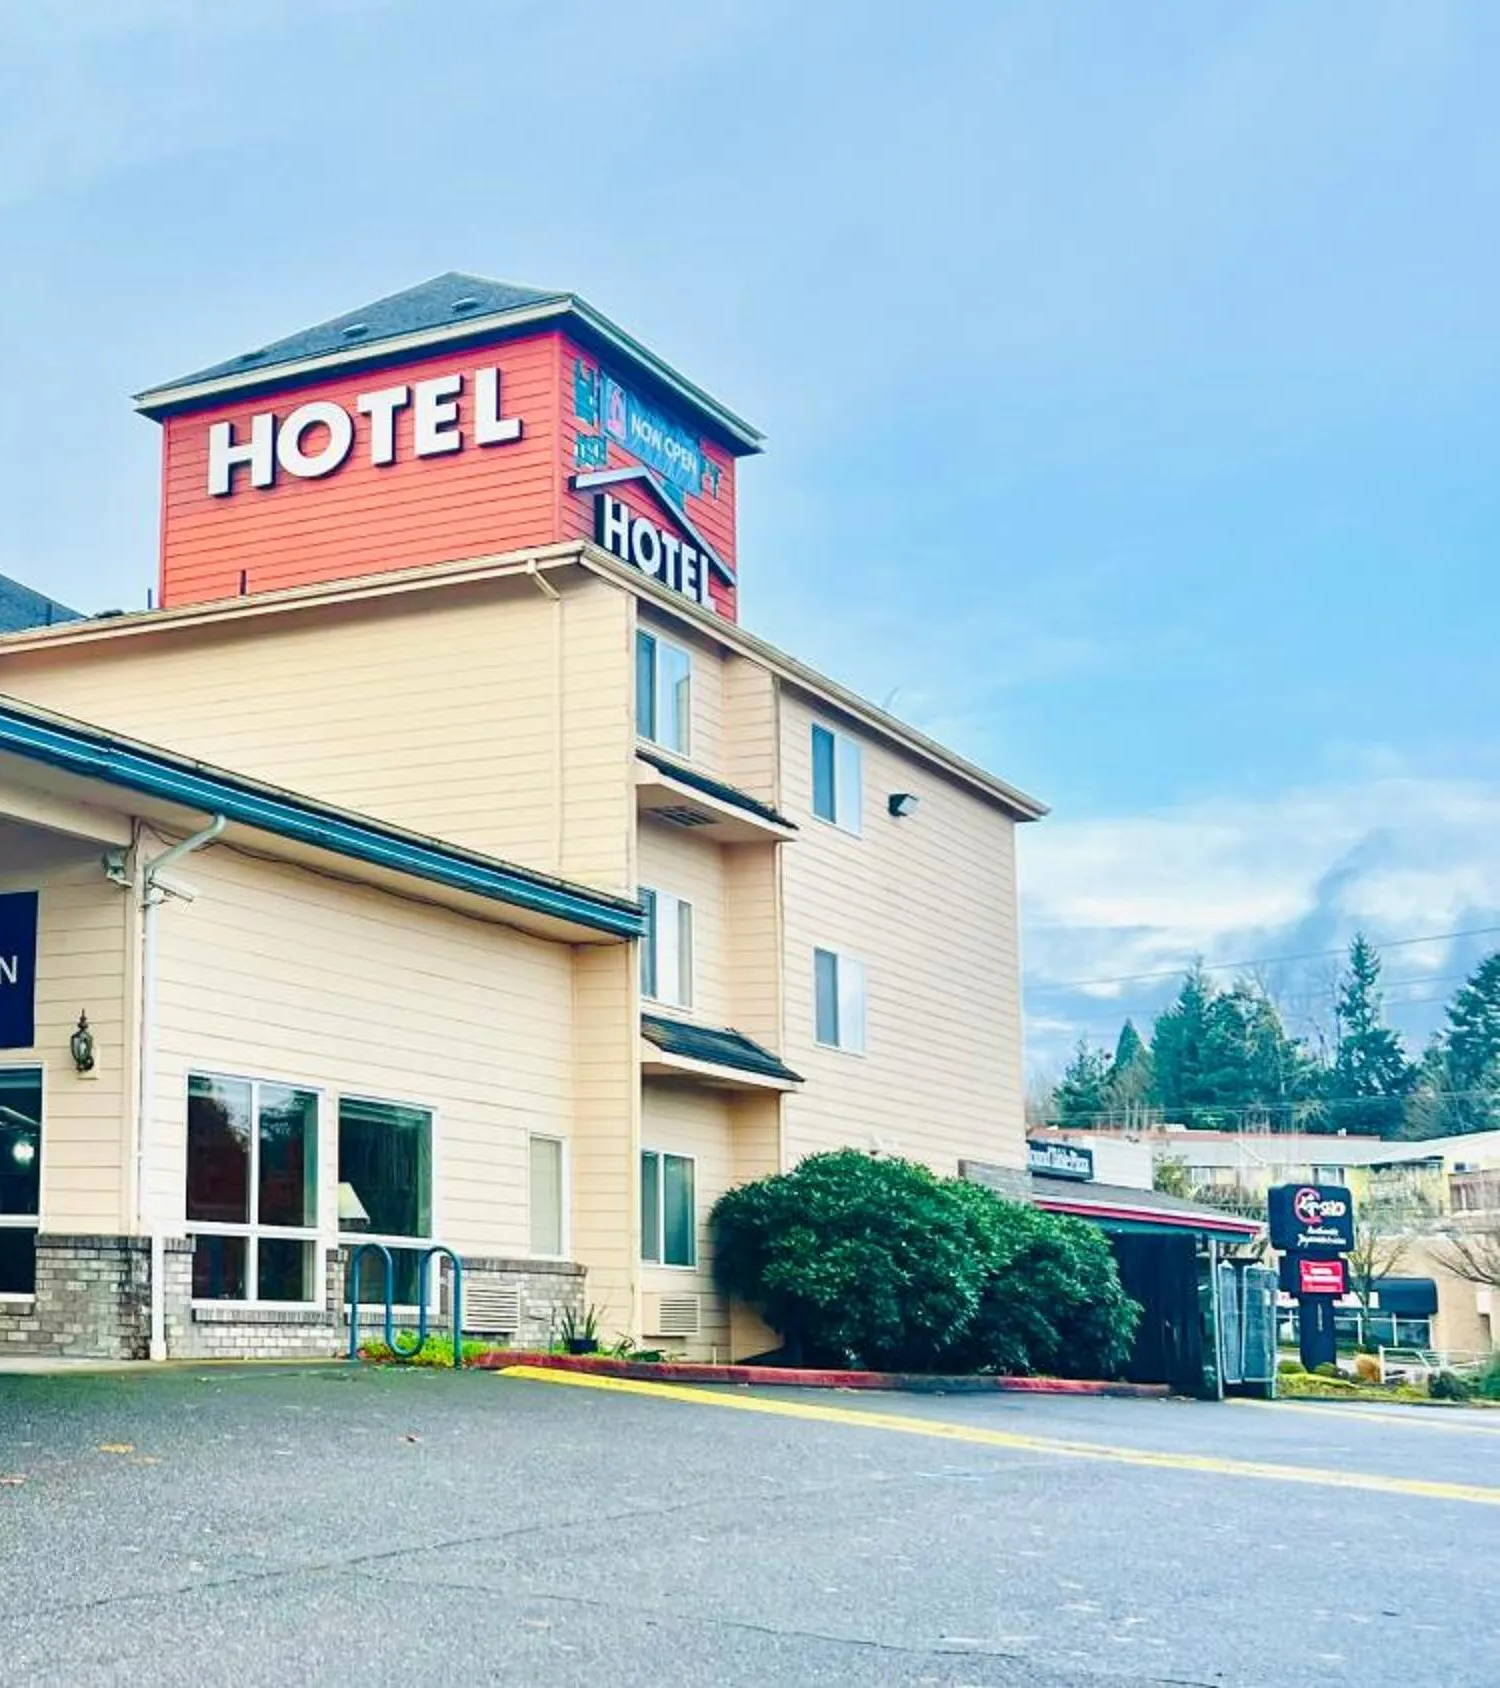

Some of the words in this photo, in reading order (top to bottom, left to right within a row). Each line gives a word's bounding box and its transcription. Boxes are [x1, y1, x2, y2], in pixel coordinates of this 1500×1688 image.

[207, 367, 522, 497] HOTEL
[630, 413, 662, 452] NOW
[664, 438, 698, 473] OPEN
[601, 493, 717, 612] HOTEL
